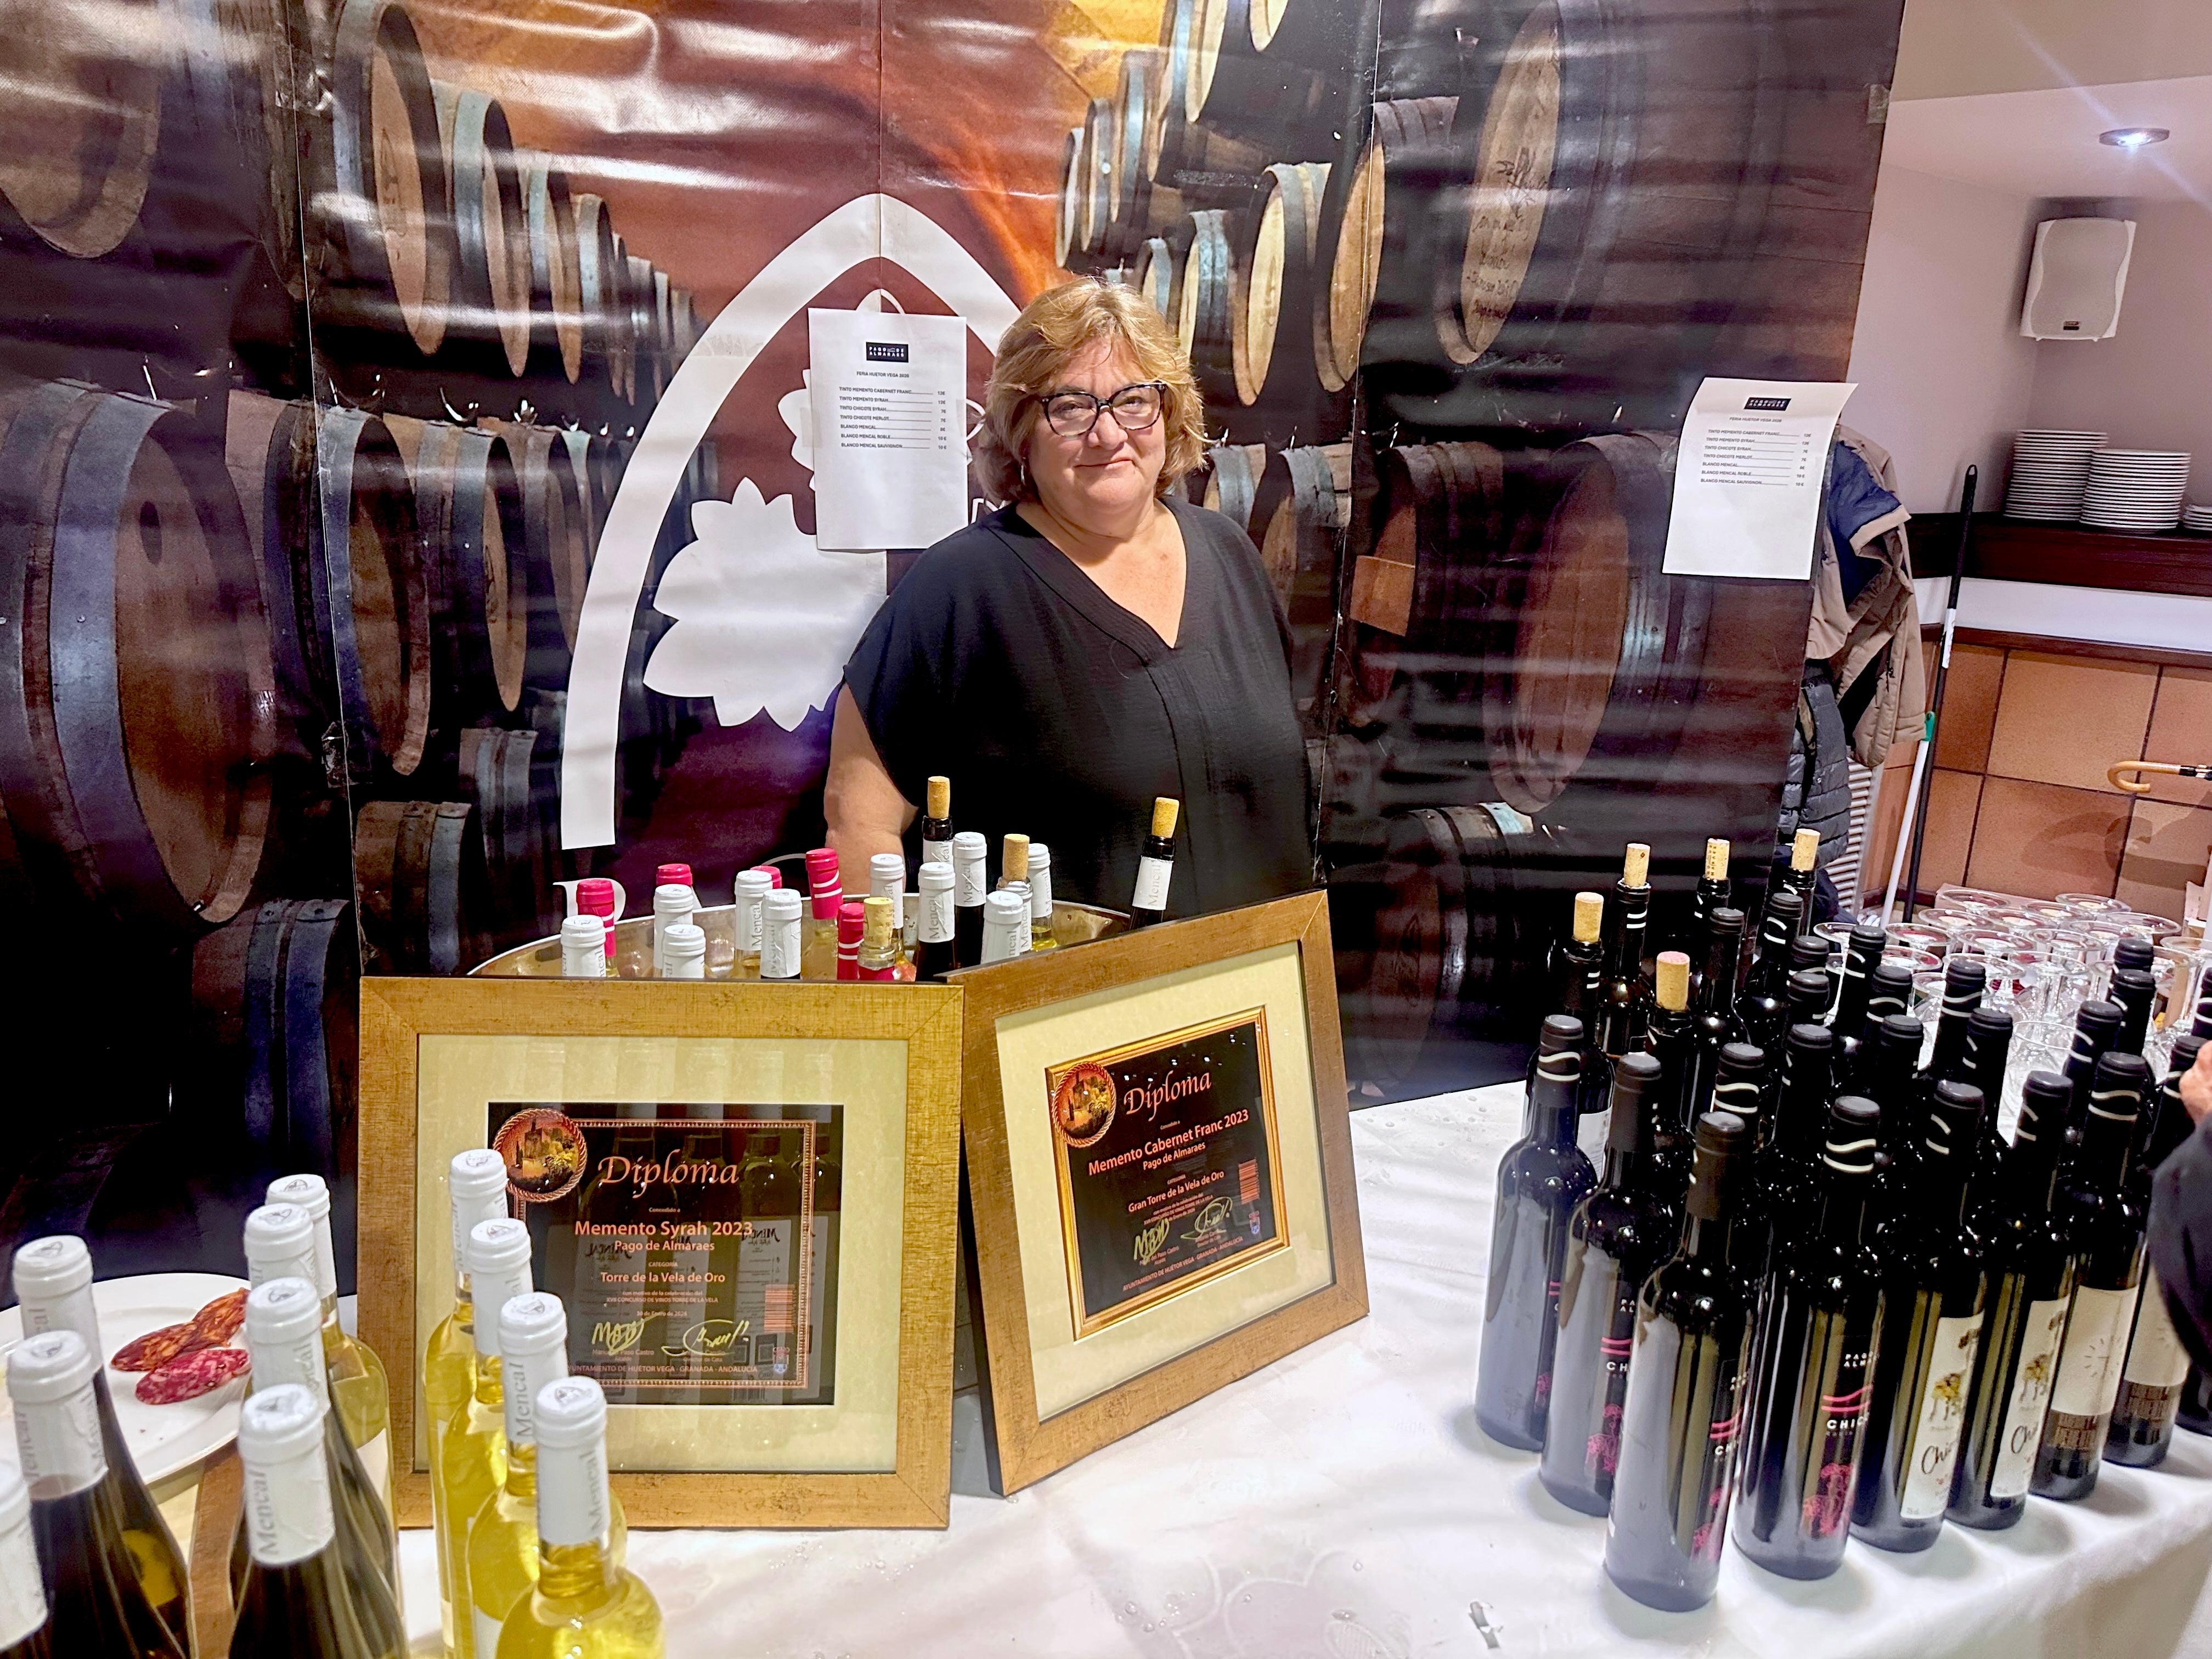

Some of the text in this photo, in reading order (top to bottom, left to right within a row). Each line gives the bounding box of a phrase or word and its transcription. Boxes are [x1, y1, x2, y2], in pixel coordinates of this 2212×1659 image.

[962, 864, 974, 903] Mencal
[1041, 872, 1052, 912] Mencal
[1148, 865, 1161, 906] Mencal
[751, 902, 762, 947] Mencal
[929, 895, 940, 940] Mencal
[595, 950, 604, 977] ncal
[1007, 930, 1017, 956] ncal
[1124, 1070, 1211, 1122] Diploma
[1088, 1109, 1249, 1176] Memento Cabernet Franc 2023
[1143, 1142, 1206, 1171] Pago de Almaraes
[598, 1149, 740, 1198] Diploma
[1128, 1171, 1224, 1212] Gran Torre de la Vela de Oro
[575, 1221, 753, 1239] Memento Syrah 2023
[614, 1240, 715, 1253] Pago de Almaraes
[600, 1272, 725, 1282] Torre de la Vela de Oro
[1123, 1272, 1158, 1291] AYUNTAMIENTO
[1158, 1269, 1165, 1277] DE
[1182, 1256, 1194, 1267] VEGA
[1197, 1247, 1217, 1260] GRANADA
[1219, 1236, 1244, 1250] ANDALUCÍA
[509, 1362, 532, 1437] Mencal
[1827, 1416, 1864, 1429] CHIC
[579, 1449, 603, 1531] Mencal
[248, 1470, 279, 1555] Mencal
